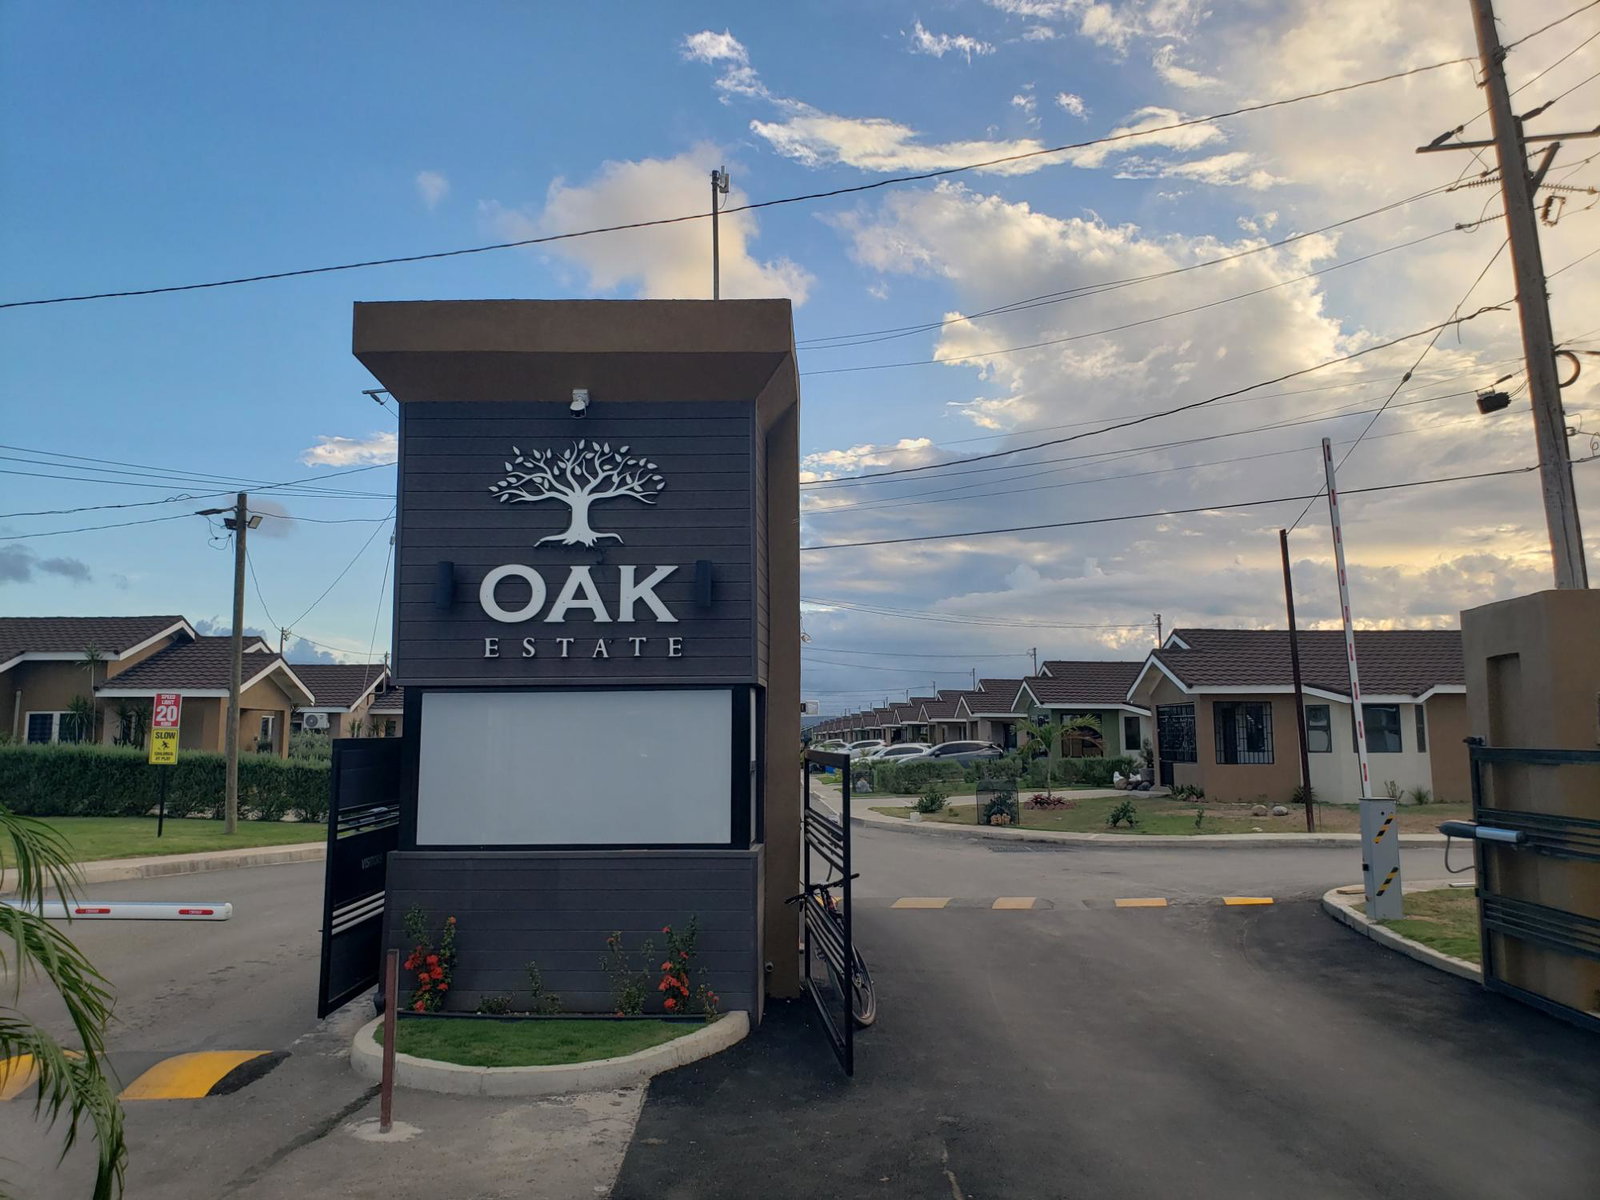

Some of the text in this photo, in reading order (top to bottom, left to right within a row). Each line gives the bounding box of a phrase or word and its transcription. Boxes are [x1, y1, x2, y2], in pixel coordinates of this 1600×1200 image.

[479, 564, 679, 623] OAK
[484, 637, 683, 658] ESTATE
[156, 705, 177, 722] 20
[155, 731, 176, 739] SLOW
